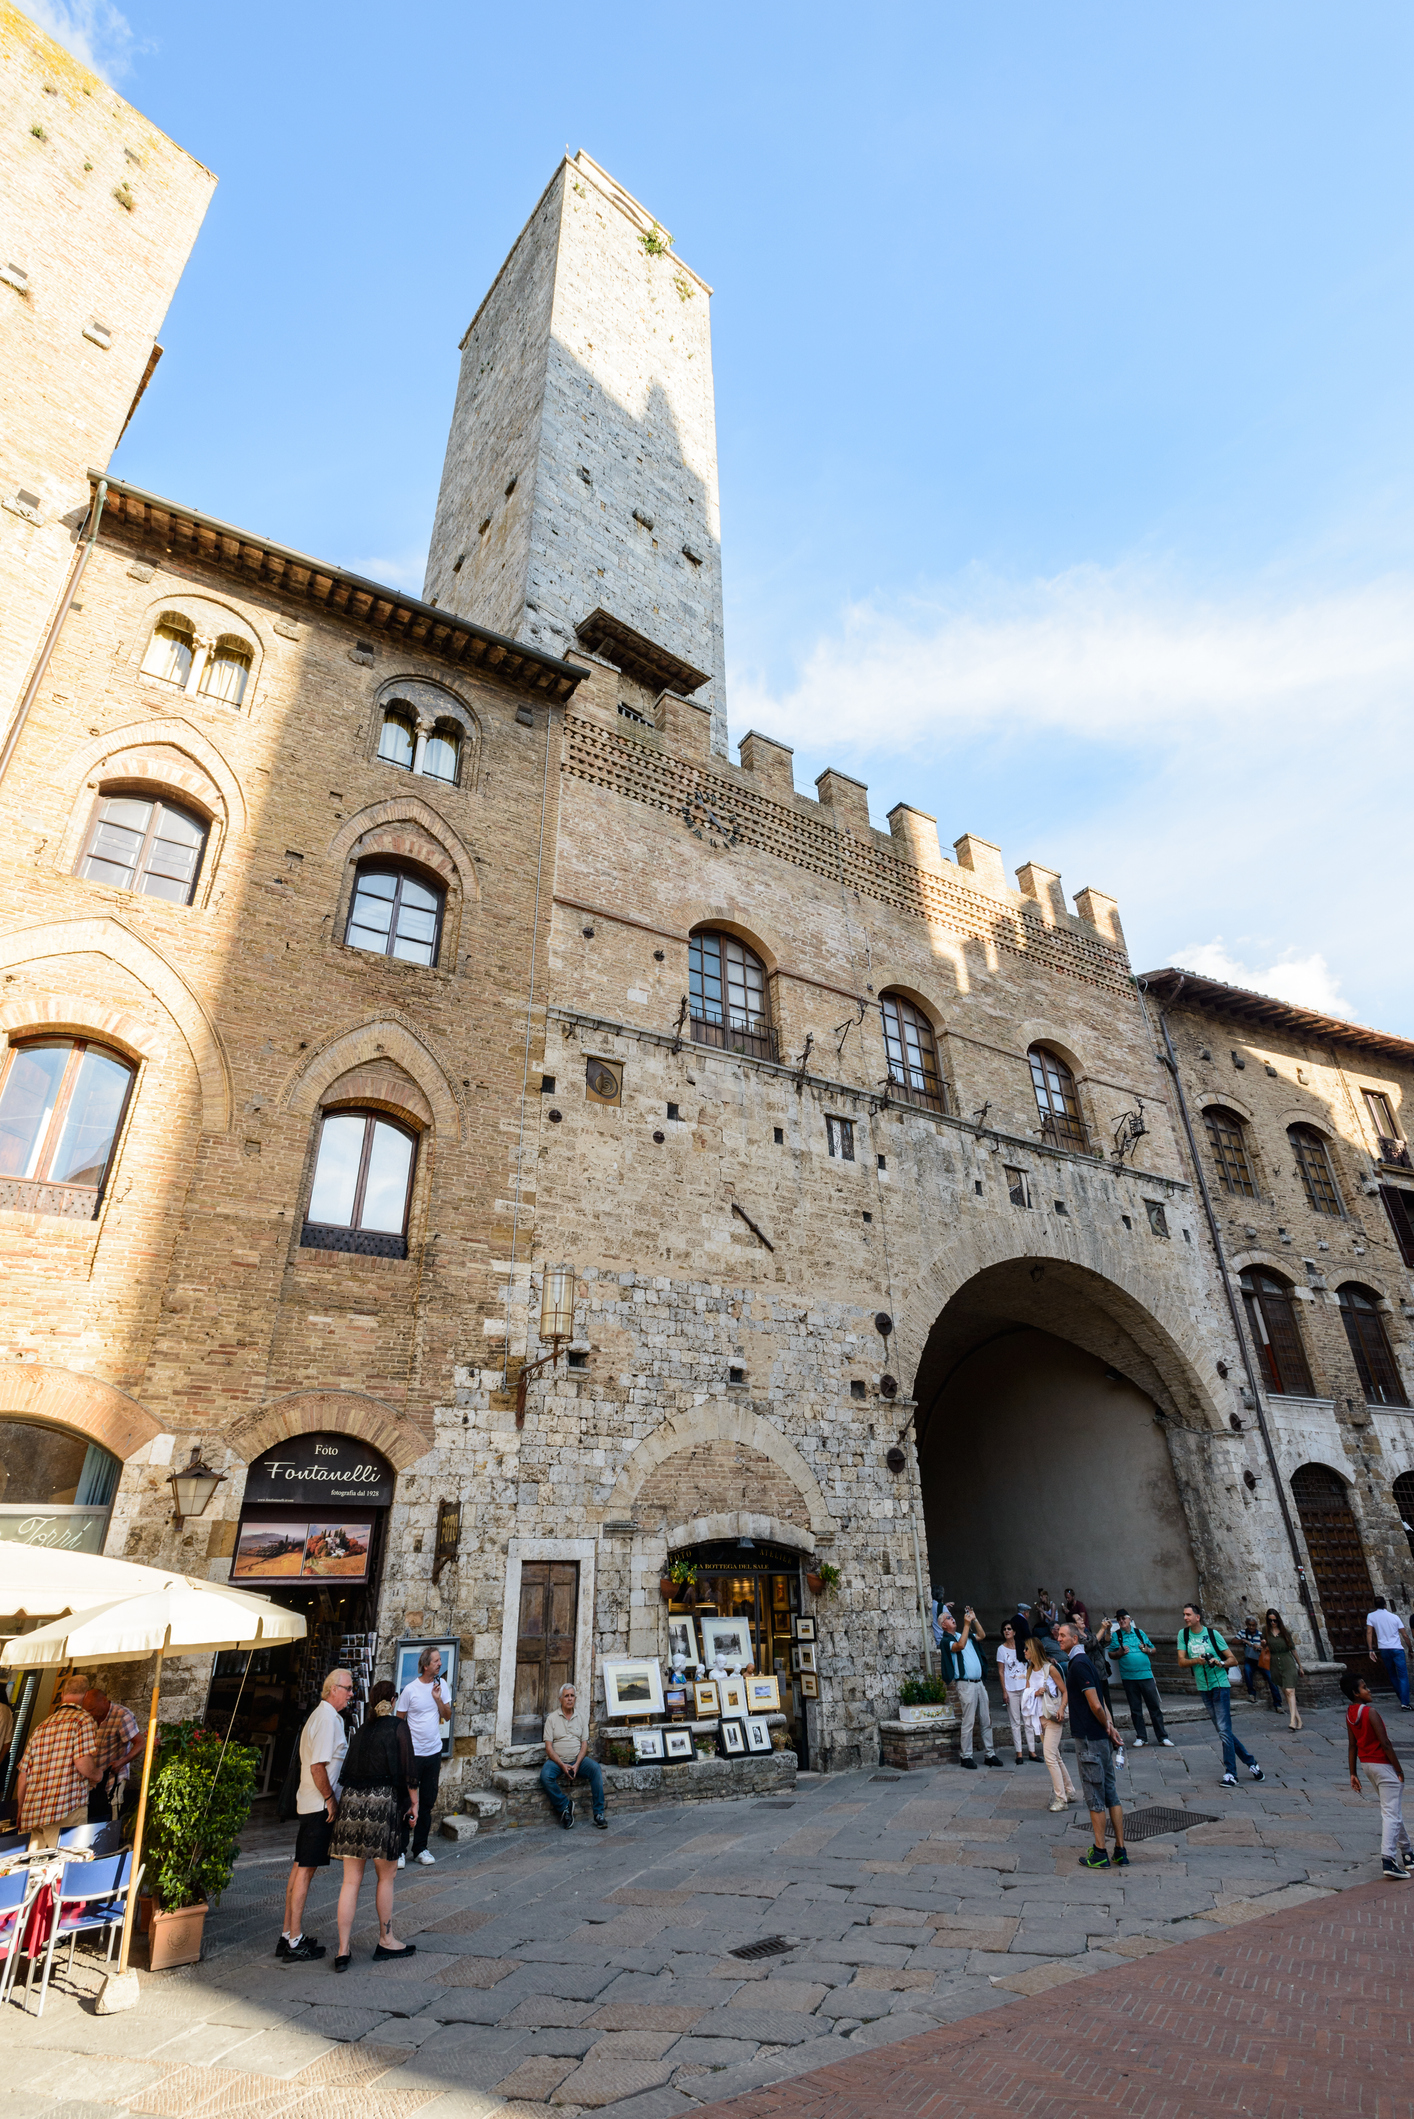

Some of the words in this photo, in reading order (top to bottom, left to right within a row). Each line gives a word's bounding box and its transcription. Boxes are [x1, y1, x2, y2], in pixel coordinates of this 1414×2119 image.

[314, 1444, 339, 1456] Foto
[264, 1461, 381, 1482] Fontanelli
[330, 1489, 356, 1498] fotografia
[18, 1516, 93, 1549] Torri
[668, 1549, 692, 1564] FOTO
